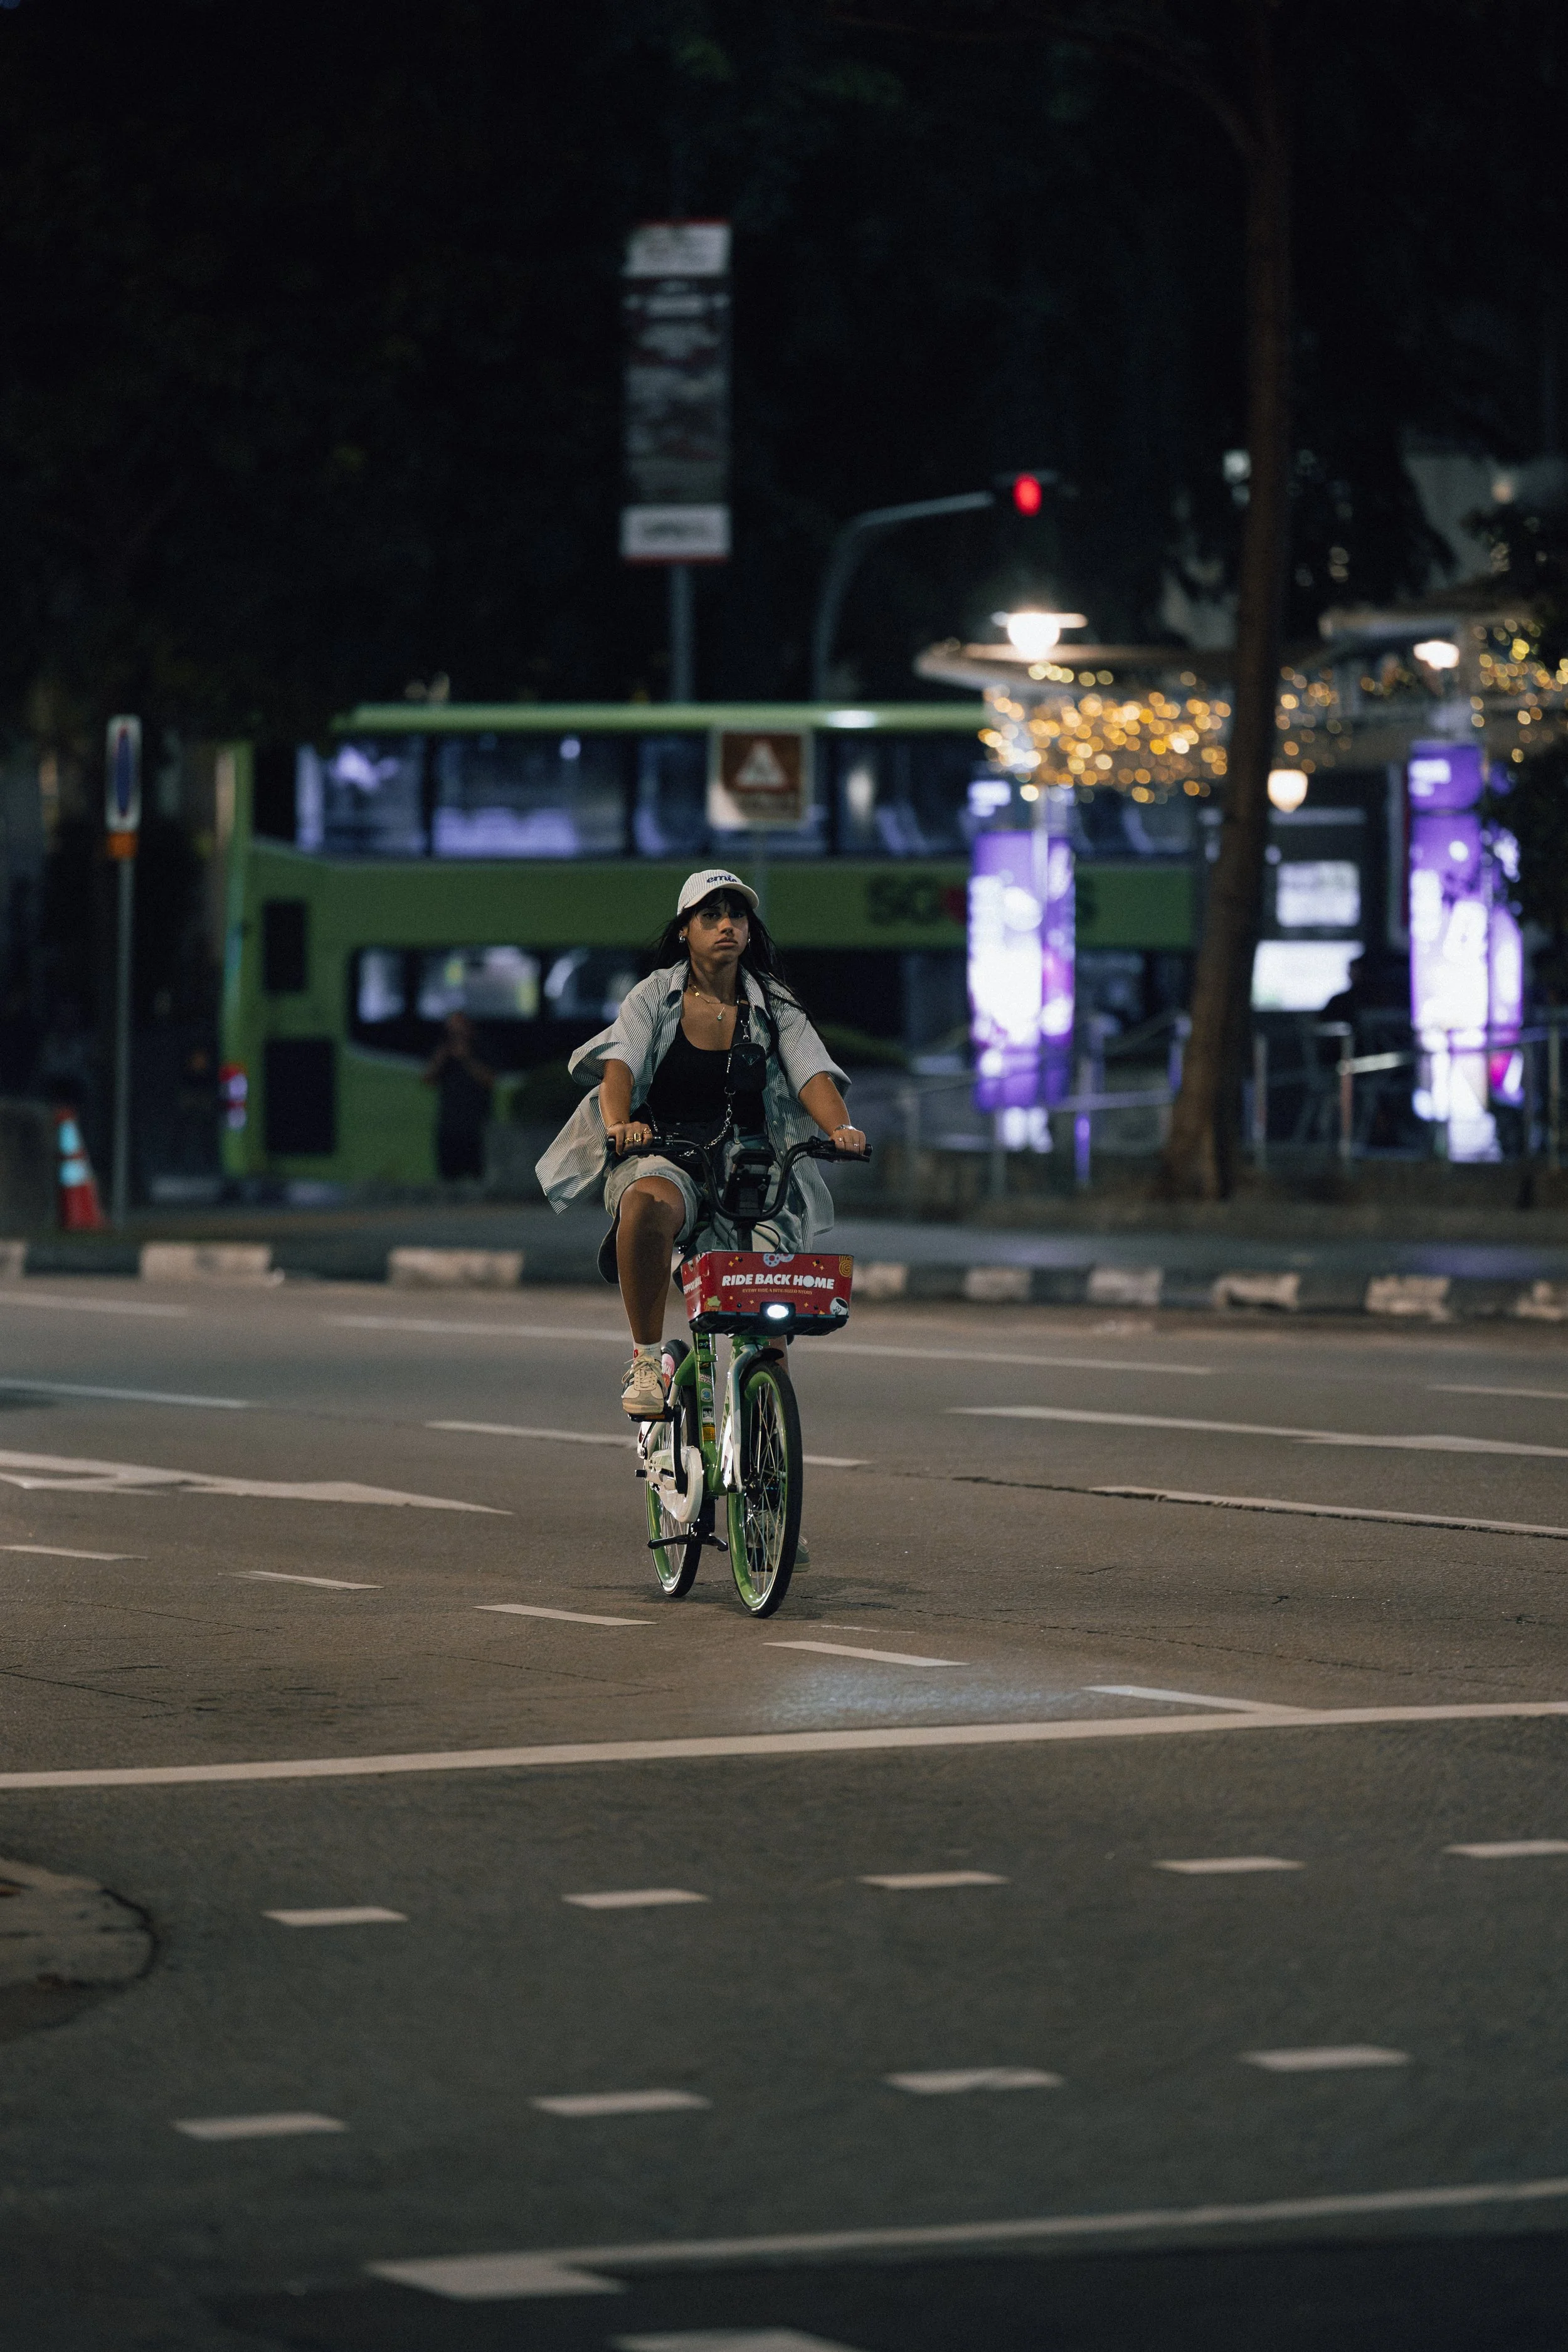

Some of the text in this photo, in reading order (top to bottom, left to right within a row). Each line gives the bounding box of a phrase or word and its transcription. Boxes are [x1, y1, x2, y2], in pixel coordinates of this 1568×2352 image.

[722, 1274, 835, 1290] RIDE BACK HOME
